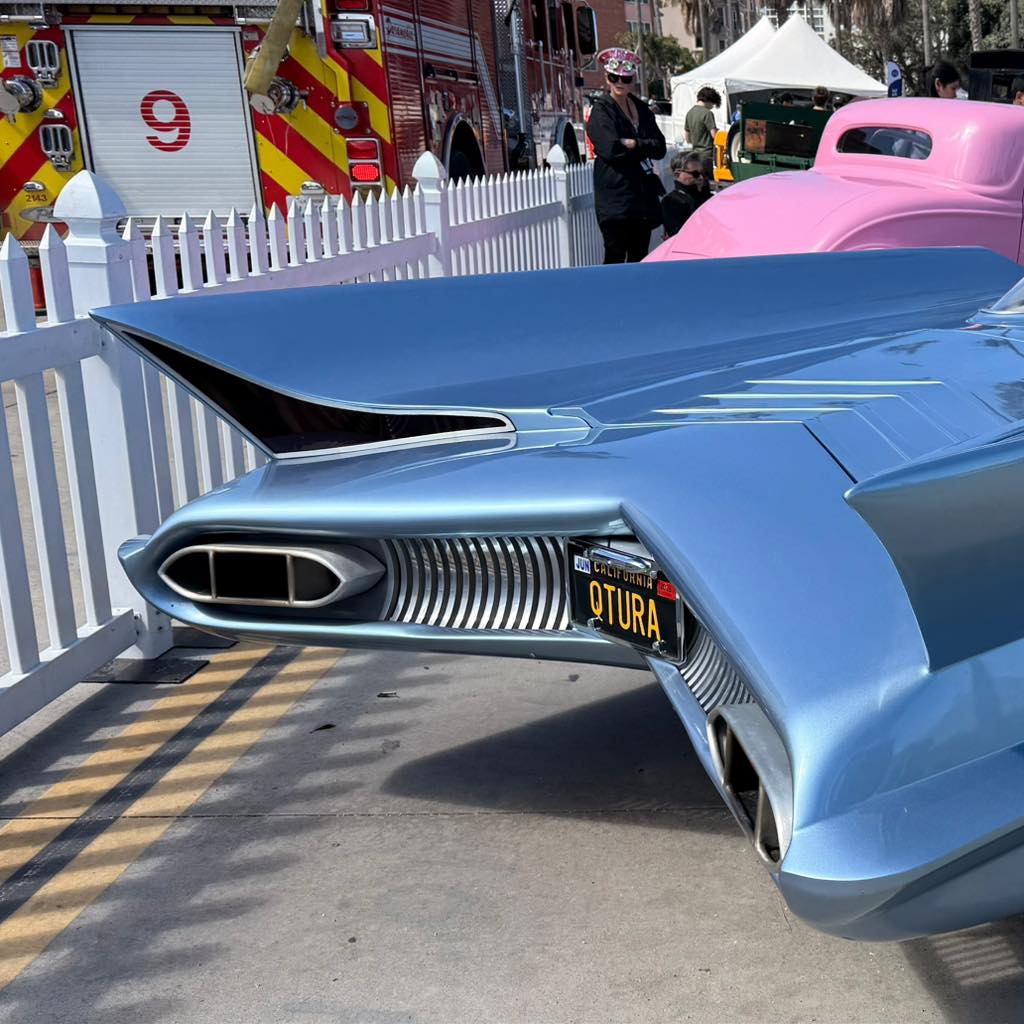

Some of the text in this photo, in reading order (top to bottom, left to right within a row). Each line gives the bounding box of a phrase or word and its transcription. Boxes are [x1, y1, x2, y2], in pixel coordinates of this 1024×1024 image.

[140, 89, 191, 152] 9
[26, 194, 47, 202] 2143
[576, 557, 590, 571] JUN
[593, 561, 653, 590] CALIFORNIA
[589, 580, 661, 641] QTURA
